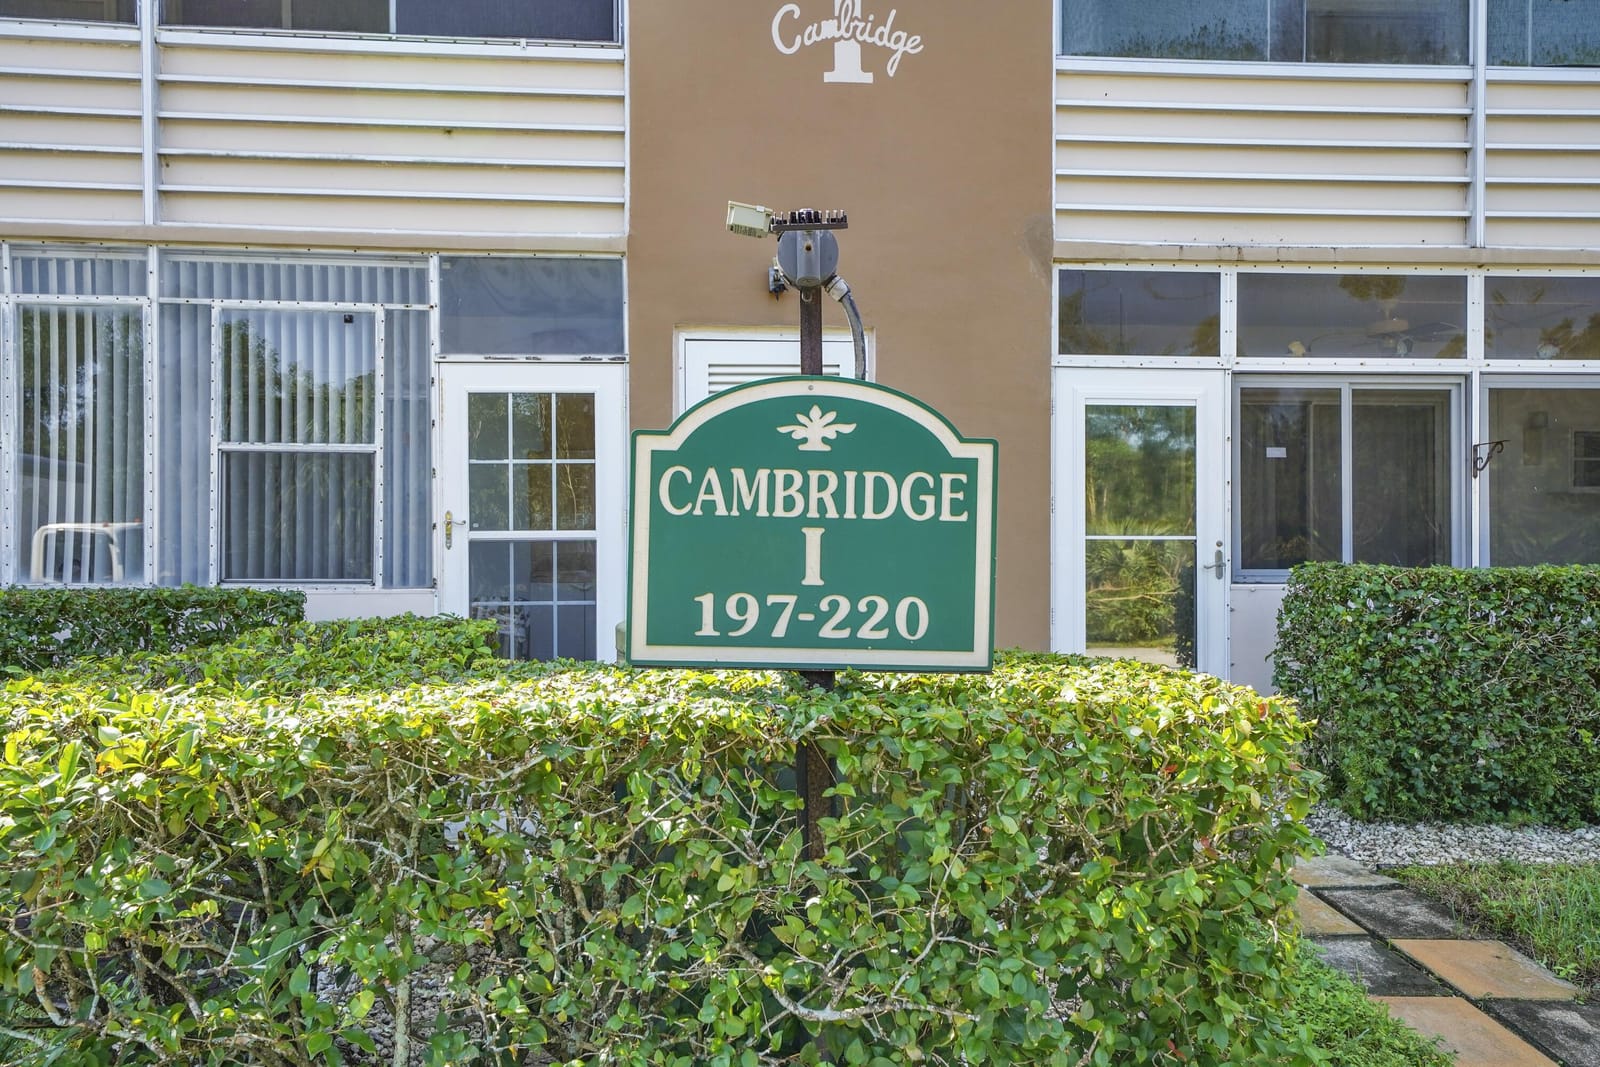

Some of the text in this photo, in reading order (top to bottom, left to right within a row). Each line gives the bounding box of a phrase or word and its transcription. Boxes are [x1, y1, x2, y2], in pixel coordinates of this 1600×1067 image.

[771, 0, 924, 77] Cambridge
[658, 465, 969, 521] CAMBRIDGE
[694, 592, 929, 640] 197-220
